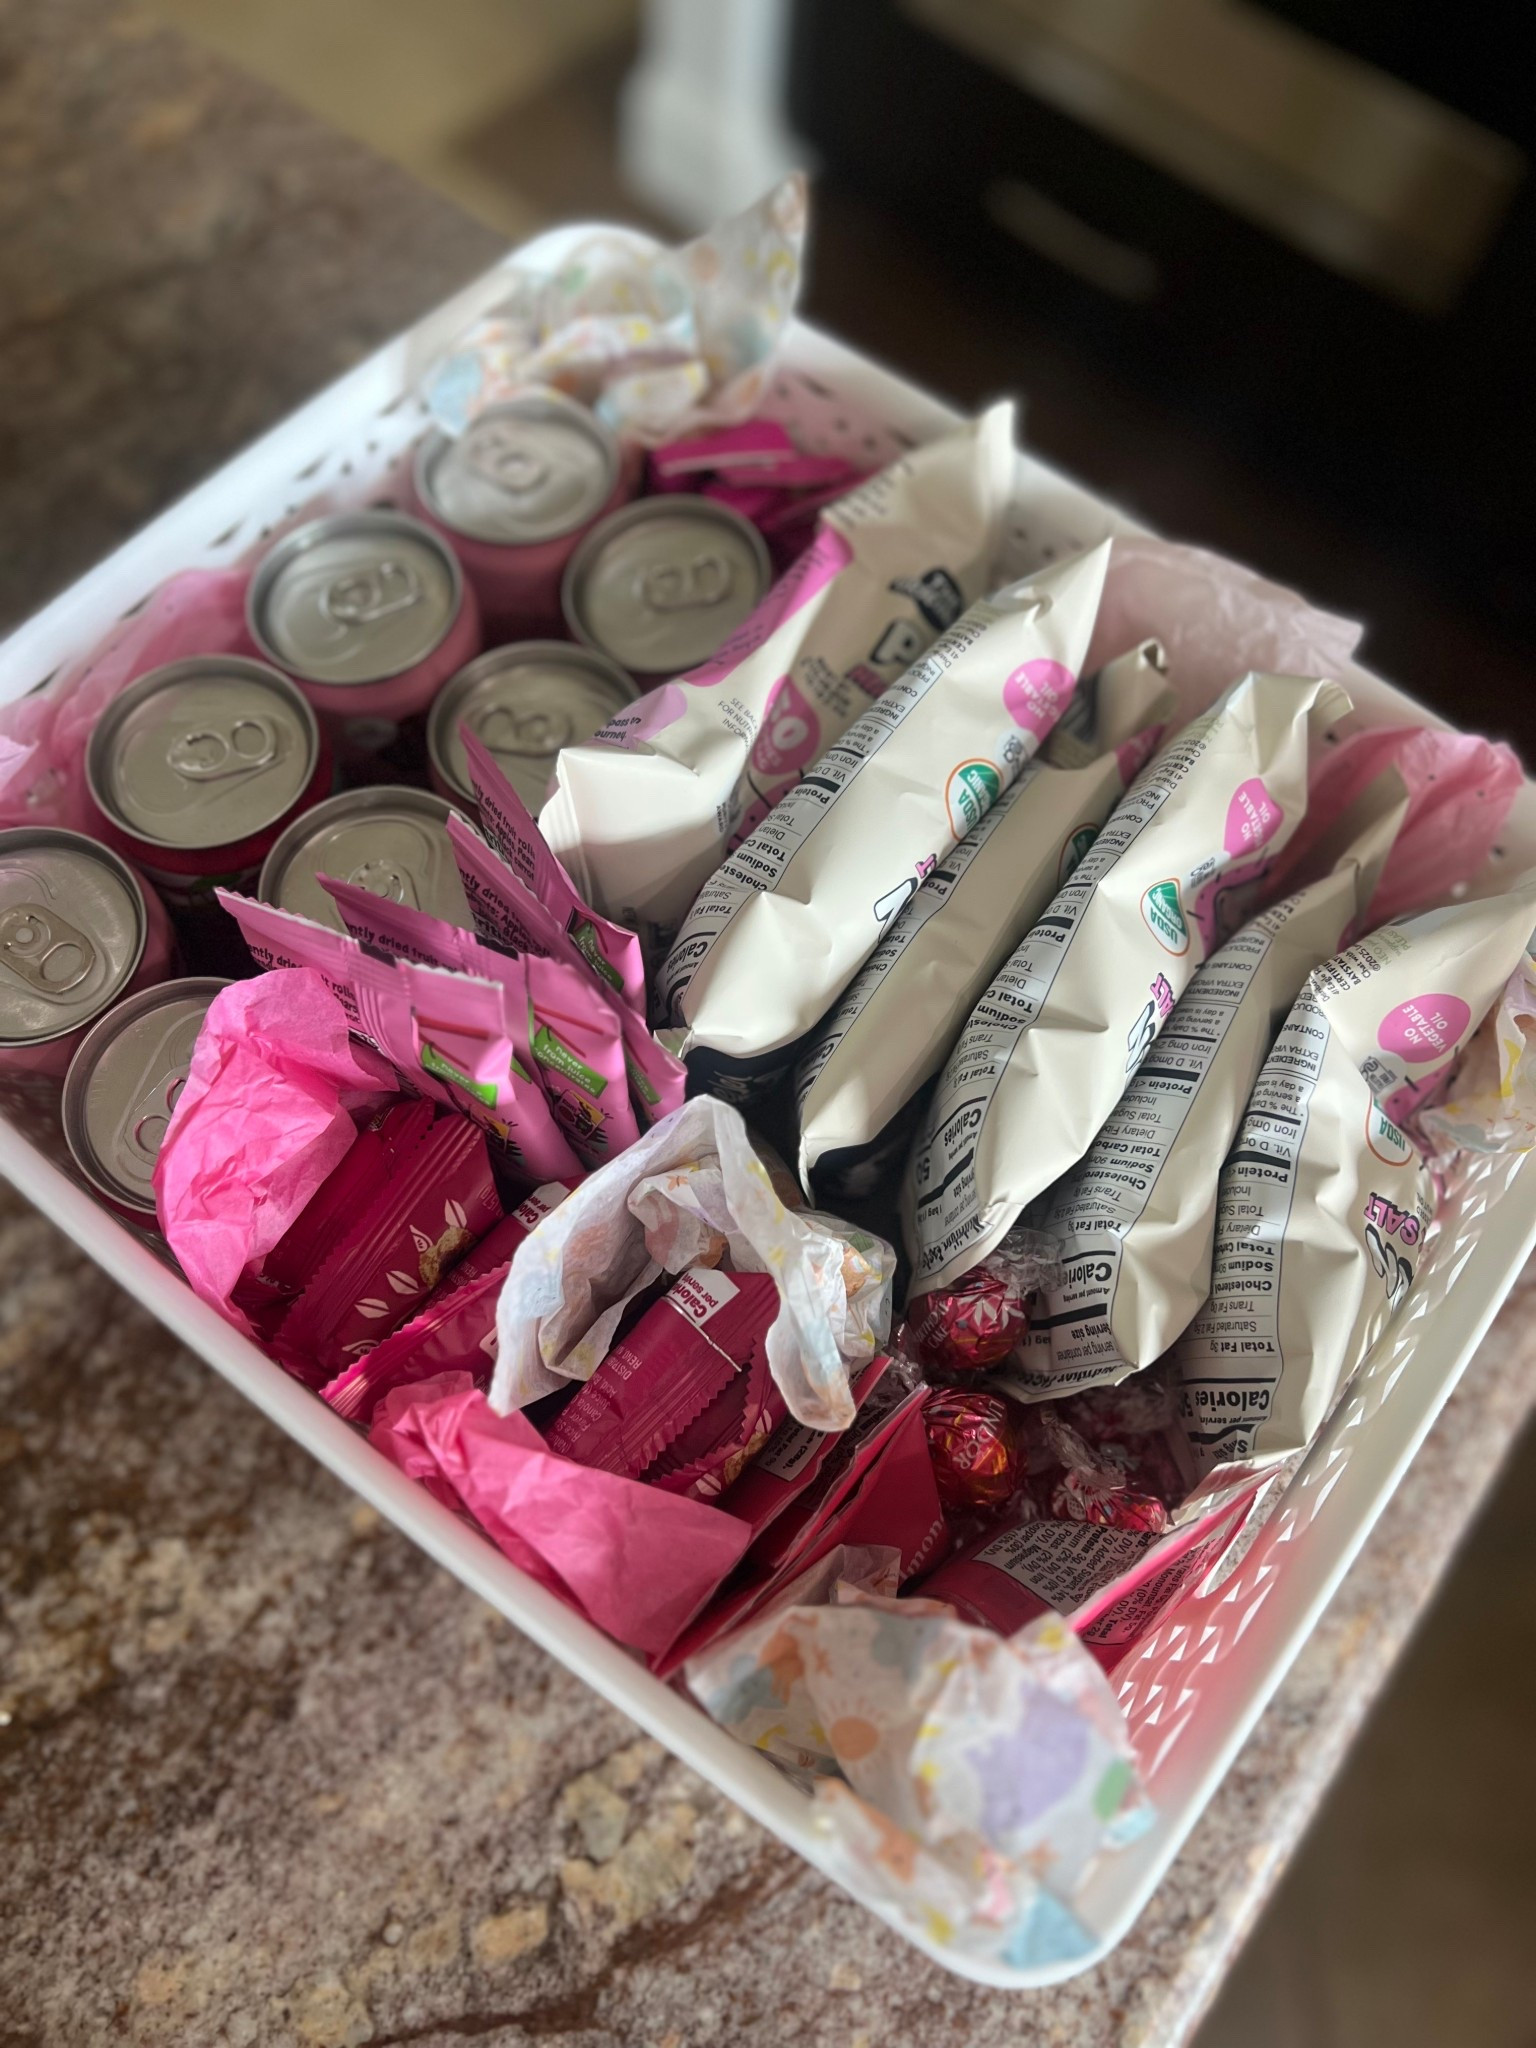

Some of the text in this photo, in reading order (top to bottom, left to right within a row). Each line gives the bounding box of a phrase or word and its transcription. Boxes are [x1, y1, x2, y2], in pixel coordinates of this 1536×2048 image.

[716, 700, 735, 716] FOR
[838, 752, 858, 770] Iron
[954, 788, 981, 829] USDA
[1257, 801, 1272, 822] OIL
[1239, 821, 1252, 841] NO
[755, 841, 787, 862] Total
[735, 849, 778, 878] Sodium
[1067, 889, 1086, 899] Iron
[704, 906, 732, 914] Total
[1143, 906, 1181, 944] USDA
[1356, 961, 1371, 978] Chat
[997, 990, 1034, 1013] Total
[1202, 1006, 1217, 1016] day
[1402, 1002, 1447, 1052] VEGETABLE
[1428, 1010, 1449, 1031] OIL
[1199, 1025, 1215, 1035] The
[1402, 1025, 1423, 1046] NO
[1166, 1037, 1212, 1054] Iron 0mg
[1185, 1058, 1204, 1069] Vit.
[1147, 1079, 1192, 1094] Protein
[1278, 1078, 1296, 1092] day
[1261, 1085, 1294, 1103] serving
[1137, 1111, 1162, 1123] Total
[1279, 1103, 1298, 1115] The
[1121, 1125, 1155, 1139] Dietary
[1272, 1124, 1296, 1139] Iron
[1373, 1117, 1410, 1151] USDA
[1131, 1144, 1161, 1156] Total
[1271, 1143, 1292, 1157] Vit.
[1110, 1156, 1154, 1174] Sodium
[1236, 1166, 1287, 1182] Protein
[1082, 1184, 1122, 1201] Trans Fat
[1075, 1203, 1116, 1214] Saturated
[1237, 1203, 1264, 1217] Total
[1074, 1220, 1092, 1230] Fat
[1093, 1219, 1122, 1231] Total
[1363, 1192, 1416, 1244] SALT
[1226, 1221, 1260, 1235] Dietary
[1236, 1241, 1274, 1254] Total
[1227, 1259, 1273, 1271] Sodium
[1214, 1281, 1272, 1292] Cholesterol
[667, 1280, 710, 1320] Calori
[700, 1290, 719, 1308] per
[1217, 1299, 1254, 1312] Trans Fat
[925, 1320, 951, 1350] CAKE
[1069, 1327, 1085, 1339] size
[1216, 1320, 1256, 1334] Saturated
[1209, 1339, 1274, 1352] Total Fat 3g
[1194, 1389, 1269, 1410] Calories
[574, 1397, 602, 1422] Canola
[952, 1399, 1004, 1467] LINDOR
[1080, 1524, 1107, 1555] Protein
[1101, 1532, 1117, 1547] 7g
[1111, 1535, 1133, 1558] DV),
[1003, 1526, 1055, 1570] DV), Magnesium
[1021, 1527, 1071, 1573] Potas. (2% DV),
[1054, 1545, 1072, 1564] (2%
[1085, 1544, 1108, 1571] Added
[1041, 1560, 1060, 1576] DV),
[1061, 1563, 1076, 1579] Vit.
[1029, 1571, 1045, 1585] Iron
[1050, 1588, 1068, 1603] 14%
[1118, 1605, 1135, 1625] DV),
[1132, 1607, 1146, 1622] Fat
[1098, 1617, 1117, 1640] Total
